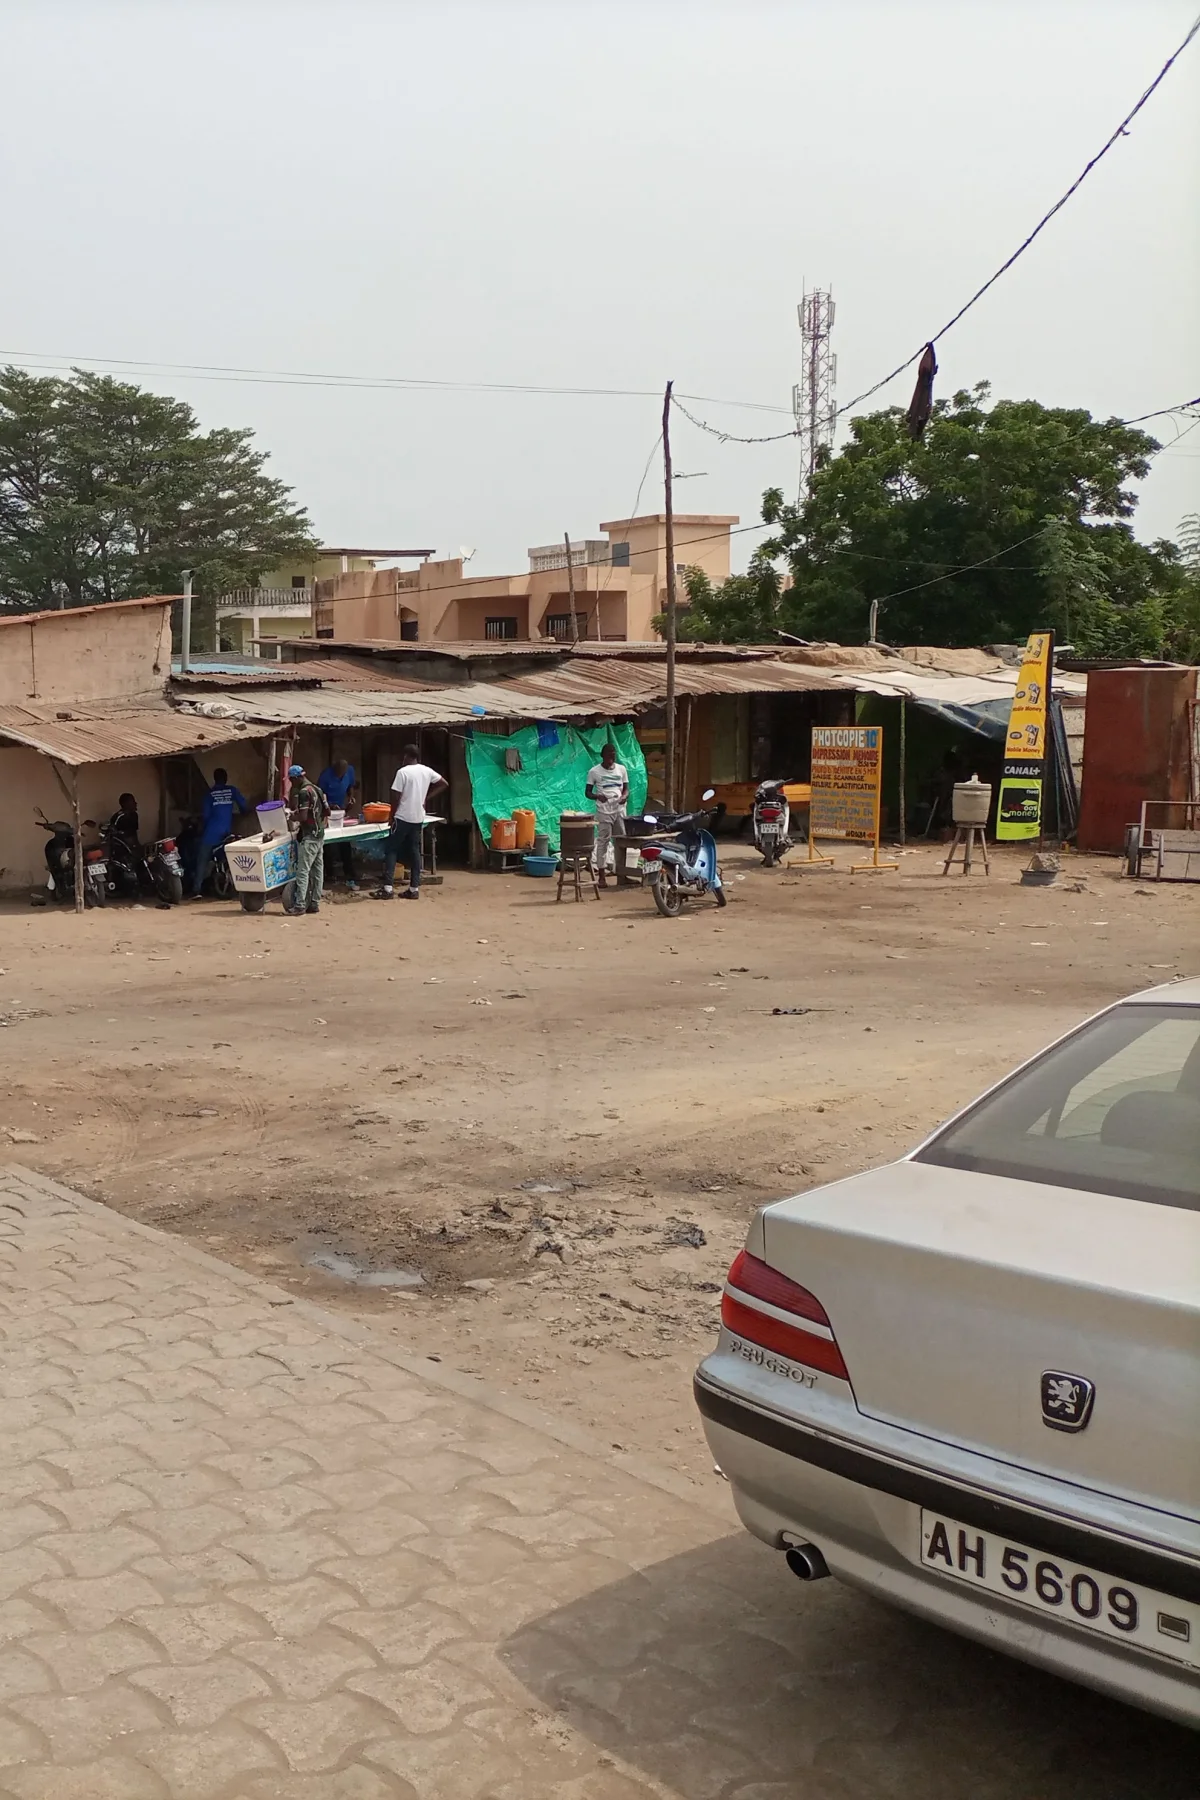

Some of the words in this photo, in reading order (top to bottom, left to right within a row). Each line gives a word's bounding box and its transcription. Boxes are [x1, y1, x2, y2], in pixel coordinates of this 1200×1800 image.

[812, 729, 865, 748] PHOTCOPIE
[1004, 765, 1041, 776] CANAL+
[729, 1340, 818, 1389] PEUGEOT
[926, 1521, 986, 1579] AH
[1000, 1546, 1140, 1633] 5609
